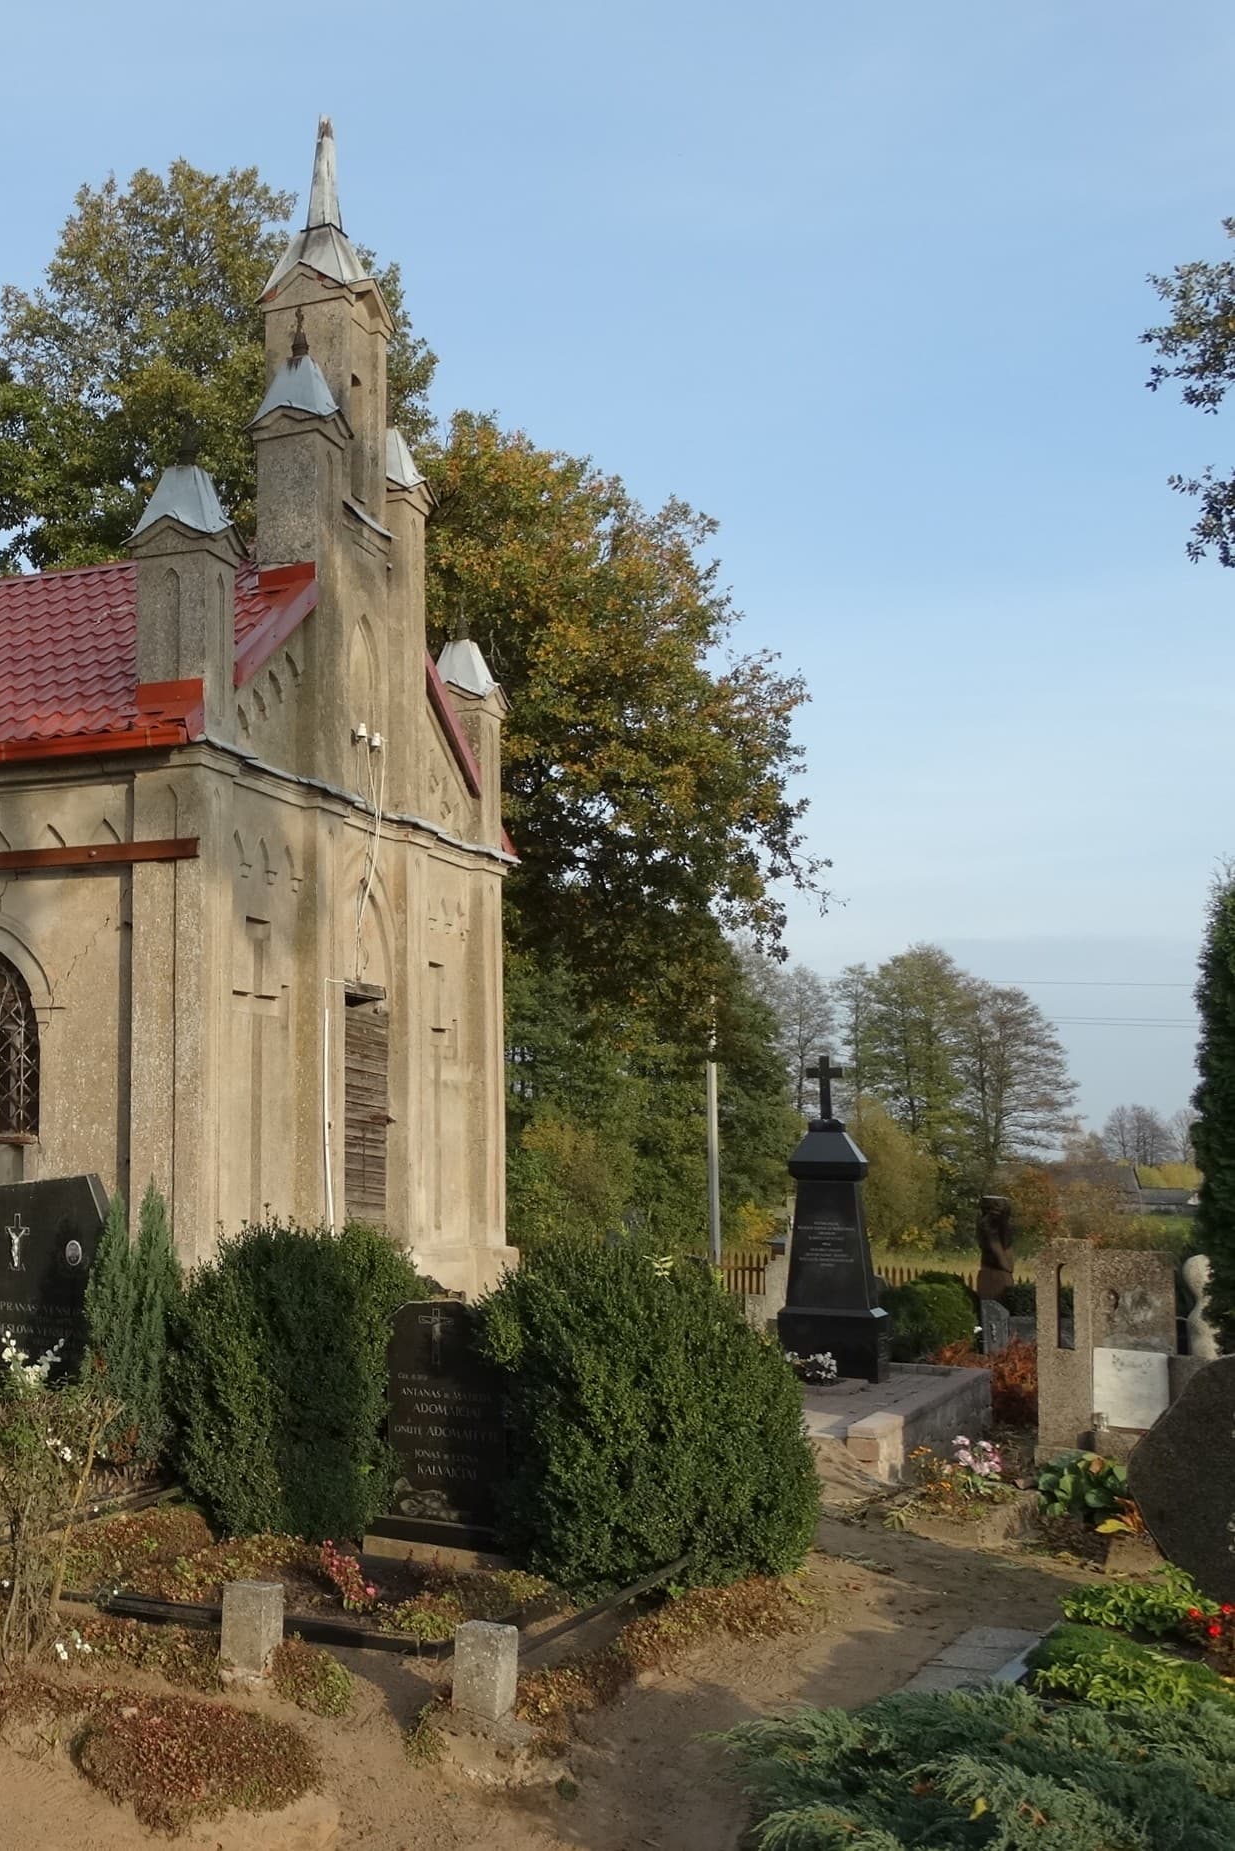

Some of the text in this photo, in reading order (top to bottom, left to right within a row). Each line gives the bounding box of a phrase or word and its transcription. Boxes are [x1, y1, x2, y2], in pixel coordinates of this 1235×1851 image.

[0, 1301, 39, 1313] PRANAS
[401, 1387, 442, 1399] ANTANAS
[414, 1448, 441, 1460] JONAS
